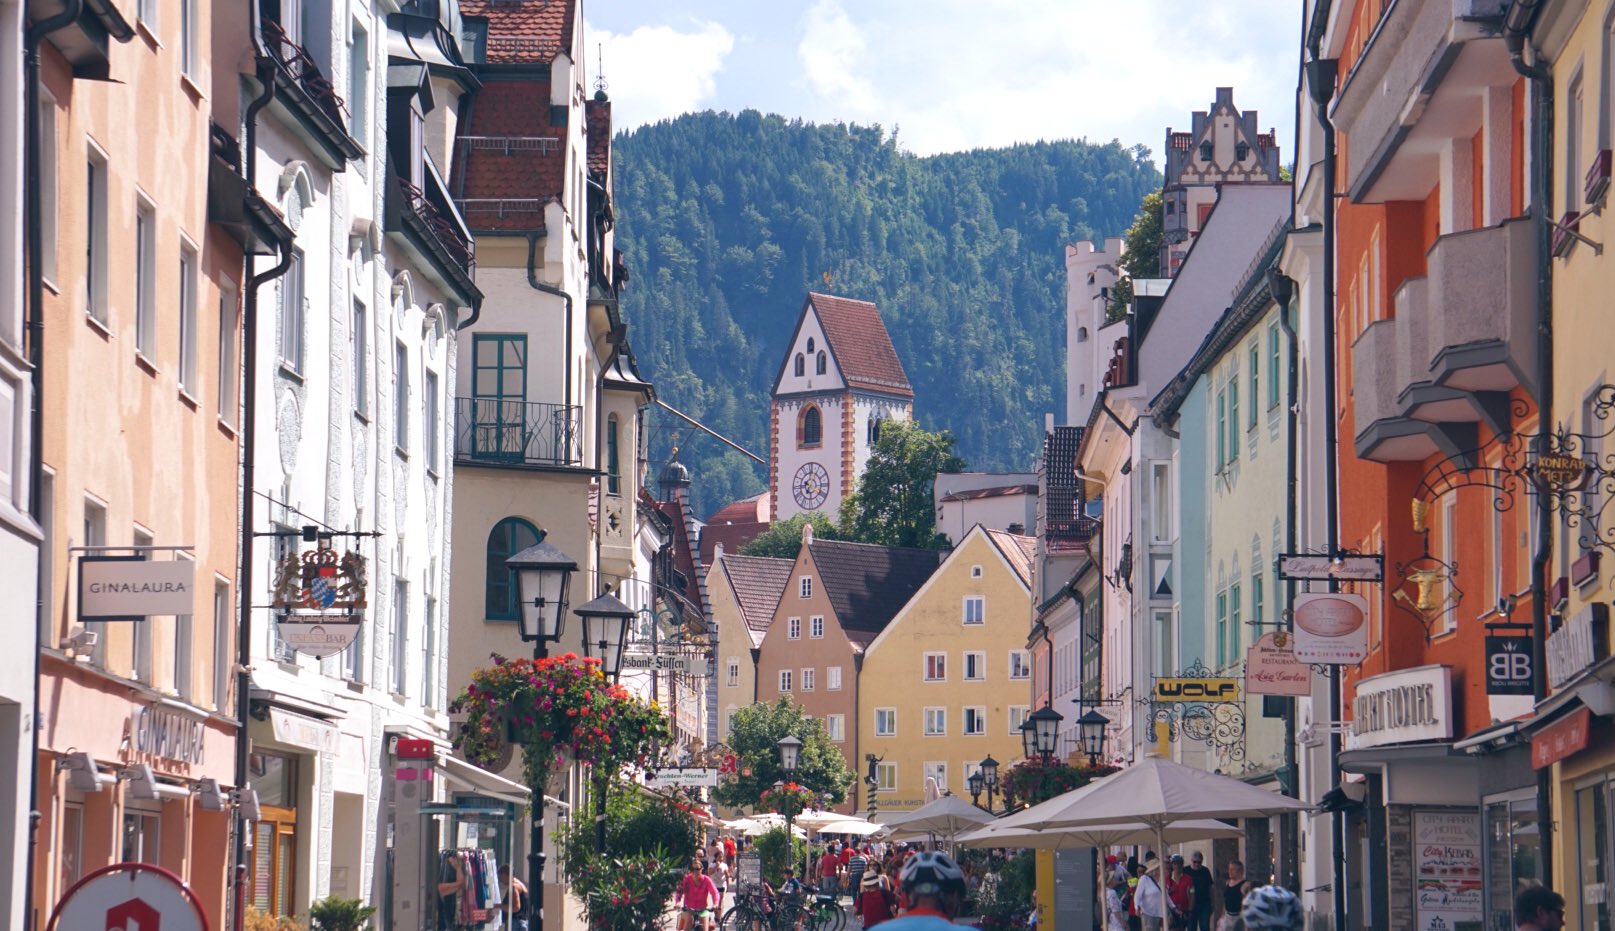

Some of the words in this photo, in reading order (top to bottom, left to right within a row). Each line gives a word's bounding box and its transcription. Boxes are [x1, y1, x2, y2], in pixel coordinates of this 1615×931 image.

[1539, 456, 1585, 469] KONRAD
[89, 582, 186, 593] GINALAURA
[622, 656, 684, 670] ksbank-Füssen
[1158, 683, 1234, 697] WOLF
[1383, 683, 1439, 730] HOTEL
[1423, 846, 1443, 858] City
